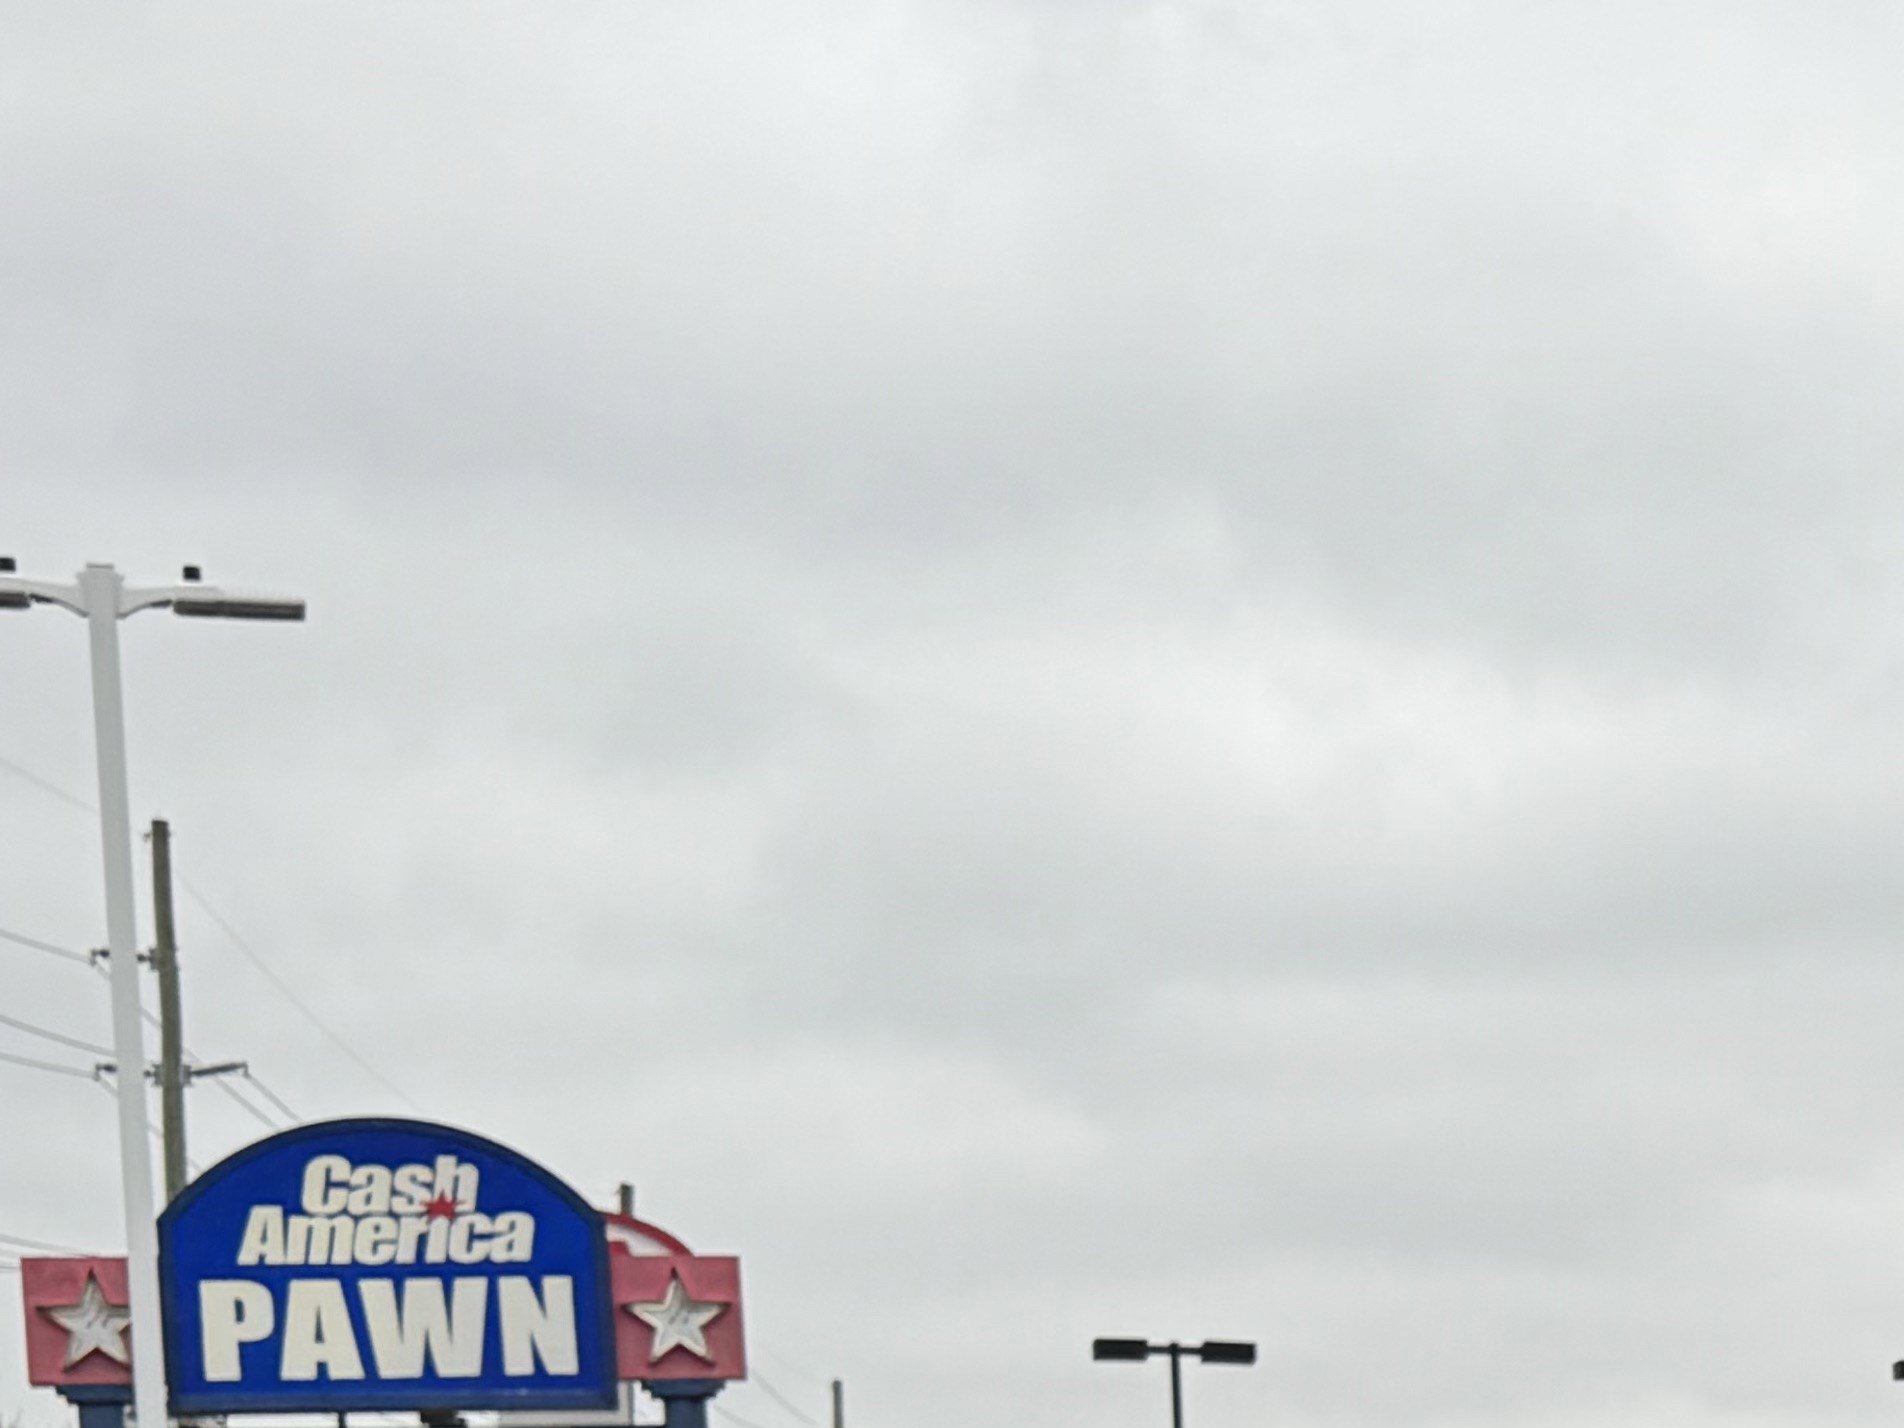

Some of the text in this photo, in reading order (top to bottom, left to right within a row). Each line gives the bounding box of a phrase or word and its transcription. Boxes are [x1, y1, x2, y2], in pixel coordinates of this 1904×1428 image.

[302, 1154, 479, 1217] Cash
[236, 1205, 536, 1267] America
[198, 1274, 581, 1383] PAWN
